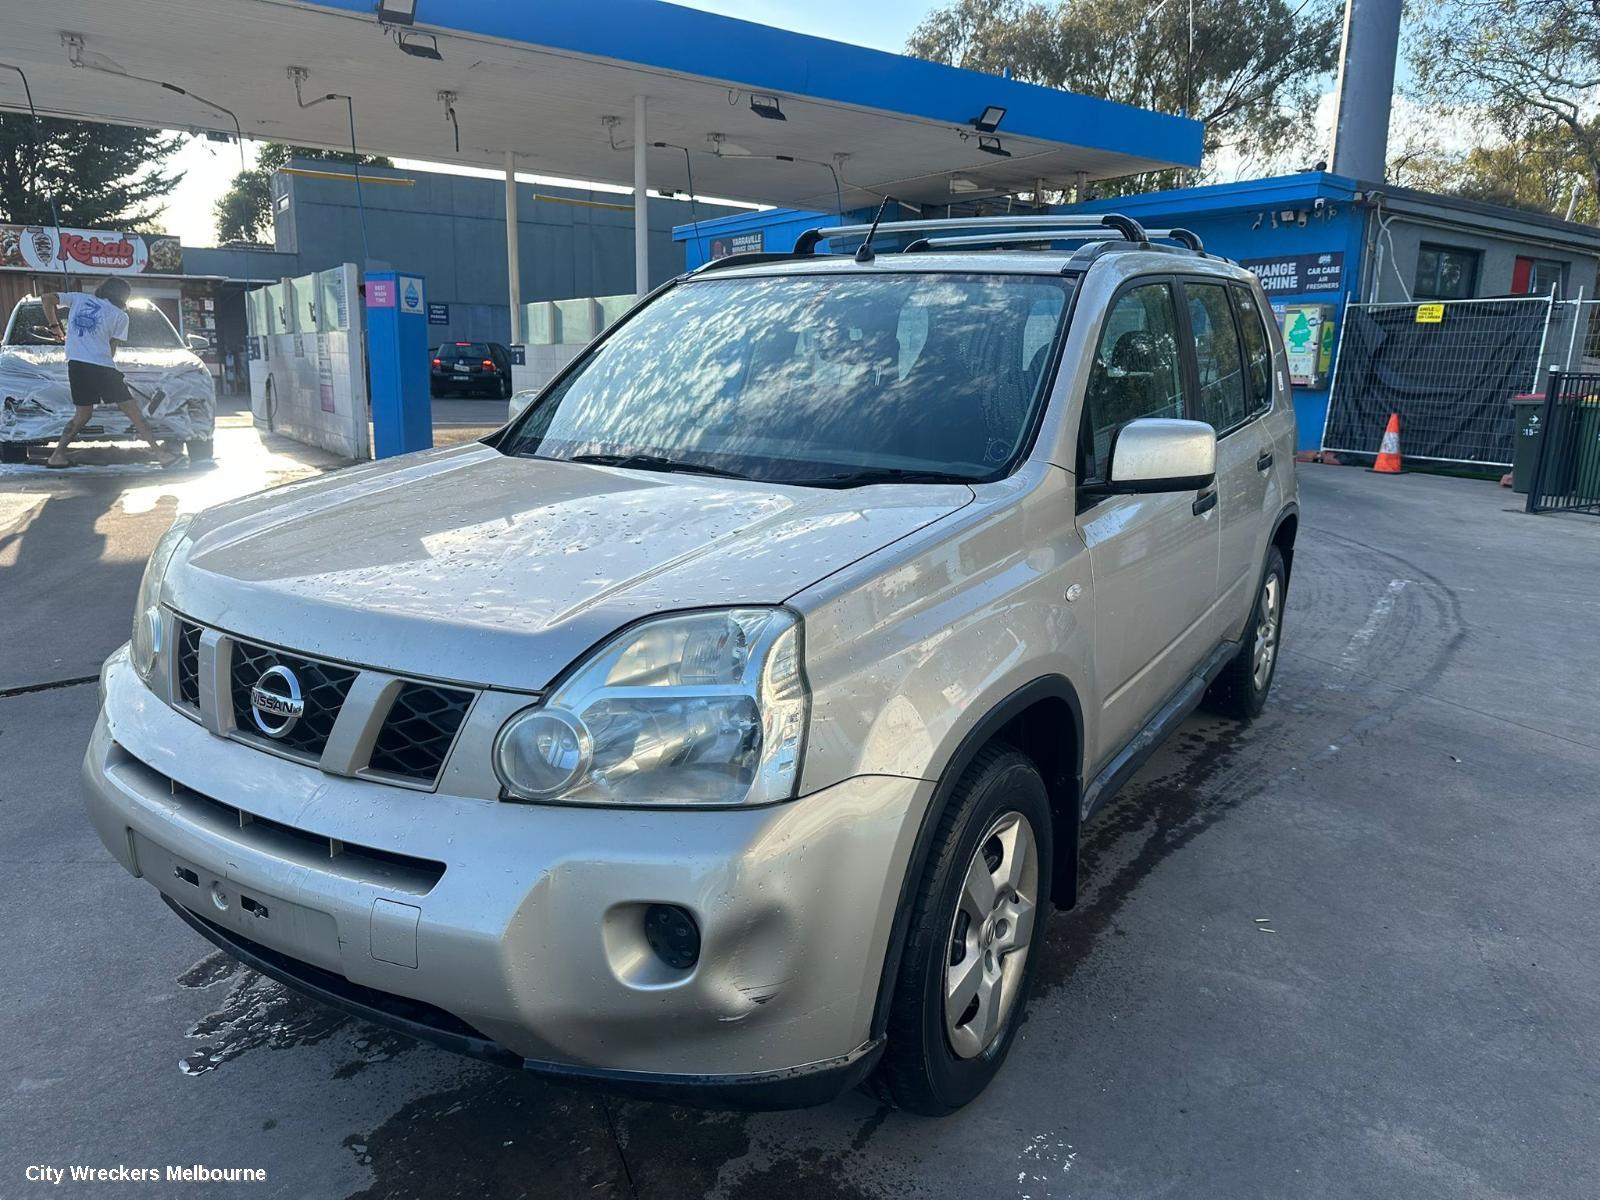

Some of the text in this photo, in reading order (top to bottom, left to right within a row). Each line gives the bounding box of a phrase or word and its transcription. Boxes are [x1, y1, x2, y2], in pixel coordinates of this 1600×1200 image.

[57, 232, 134, 260] Kebab
[732, 233, 761, 246] YARRAVILLE
[91, 256, 129, 266] BREAK
[1248, 262, 1297, 278] CHANGE
[1307, 266, 1340, 275] CAR CARE
[1261, 276, 1298, 290] CHINE
[252, 690, 294, 713] NISSAN
